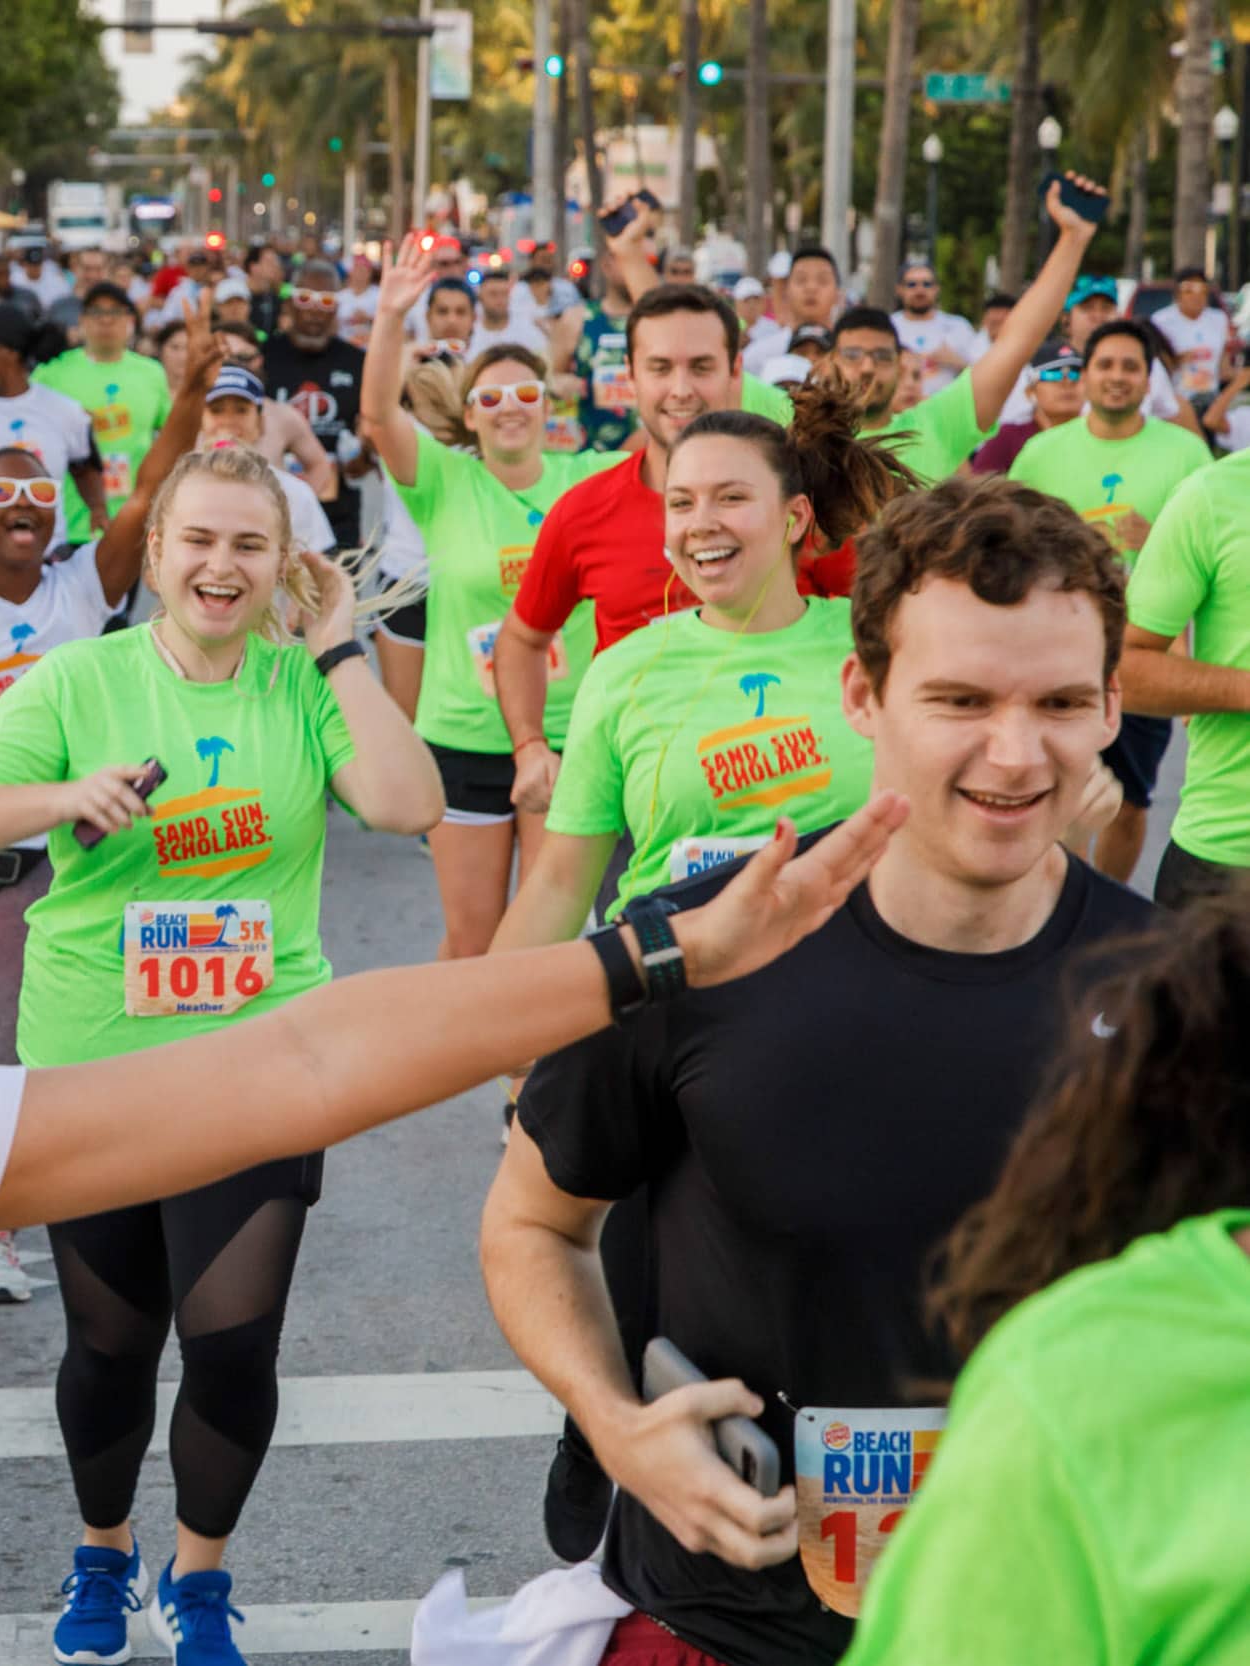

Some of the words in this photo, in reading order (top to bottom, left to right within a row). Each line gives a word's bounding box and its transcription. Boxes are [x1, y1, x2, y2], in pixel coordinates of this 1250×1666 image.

[221, 802, 270, 831] SUN.
[157, 823, 273, 866] SCHOLARS.
[141, 926, 187, 949] RUN
[156, 914, 187, 926] BEACH
[239, 920, 266, 942] 5K
[139, 955, 264, 999] 1016
[177, 1003, 224, 1013] Heather
[853, 1430, 911, 1453] BEACH
[823, 1453, 911, 1495] RUN
